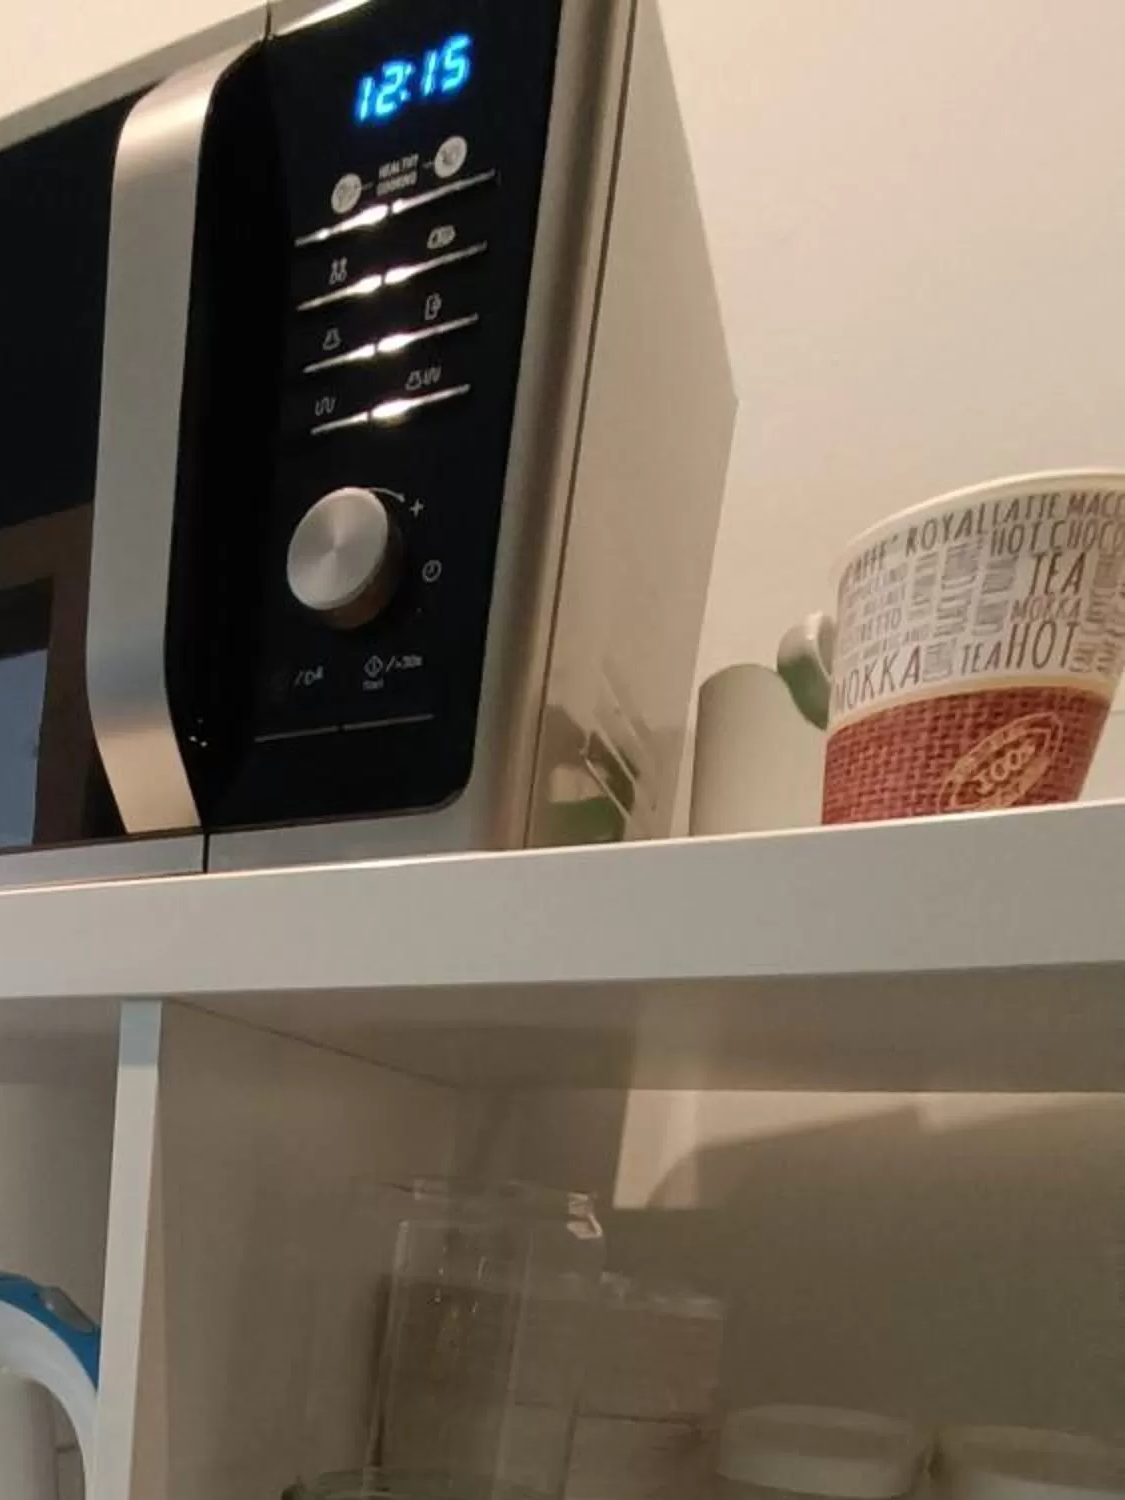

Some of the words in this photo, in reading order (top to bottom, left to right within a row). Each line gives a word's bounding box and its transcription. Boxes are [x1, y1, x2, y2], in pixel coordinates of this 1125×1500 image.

[355, 34, 472, 121] 12:15
[905, 502, 989, 557] ROYAL
[1029, 551, 1087, 597] TEA
[960, 640, 1003, 678] TEA
[1004, 619, 1081, 670] HOT
